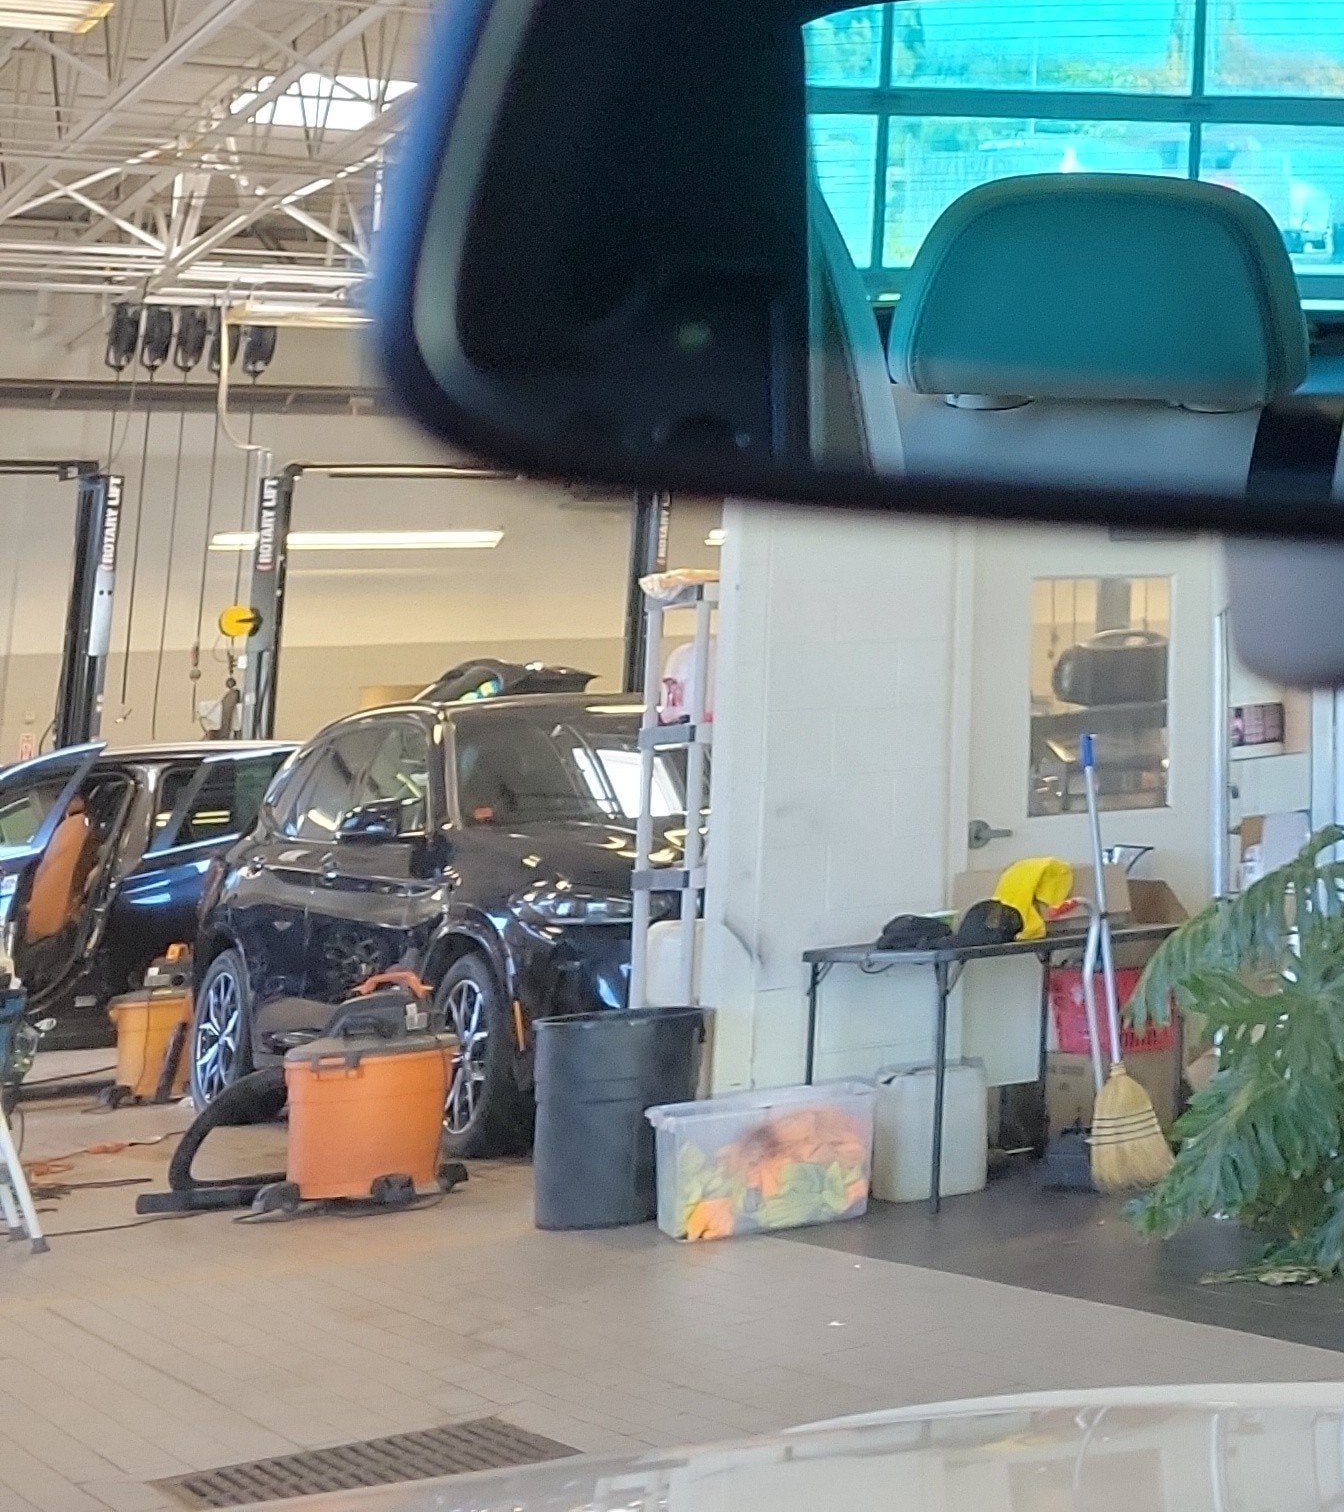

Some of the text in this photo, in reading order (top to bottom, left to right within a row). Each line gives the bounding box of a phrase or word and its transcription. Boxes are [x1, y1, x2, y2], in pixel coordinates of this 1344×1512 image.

[102, 476, 121, 563] ROTARY LIFT
[258, 478, 279, 563] ROTARY LIFT
